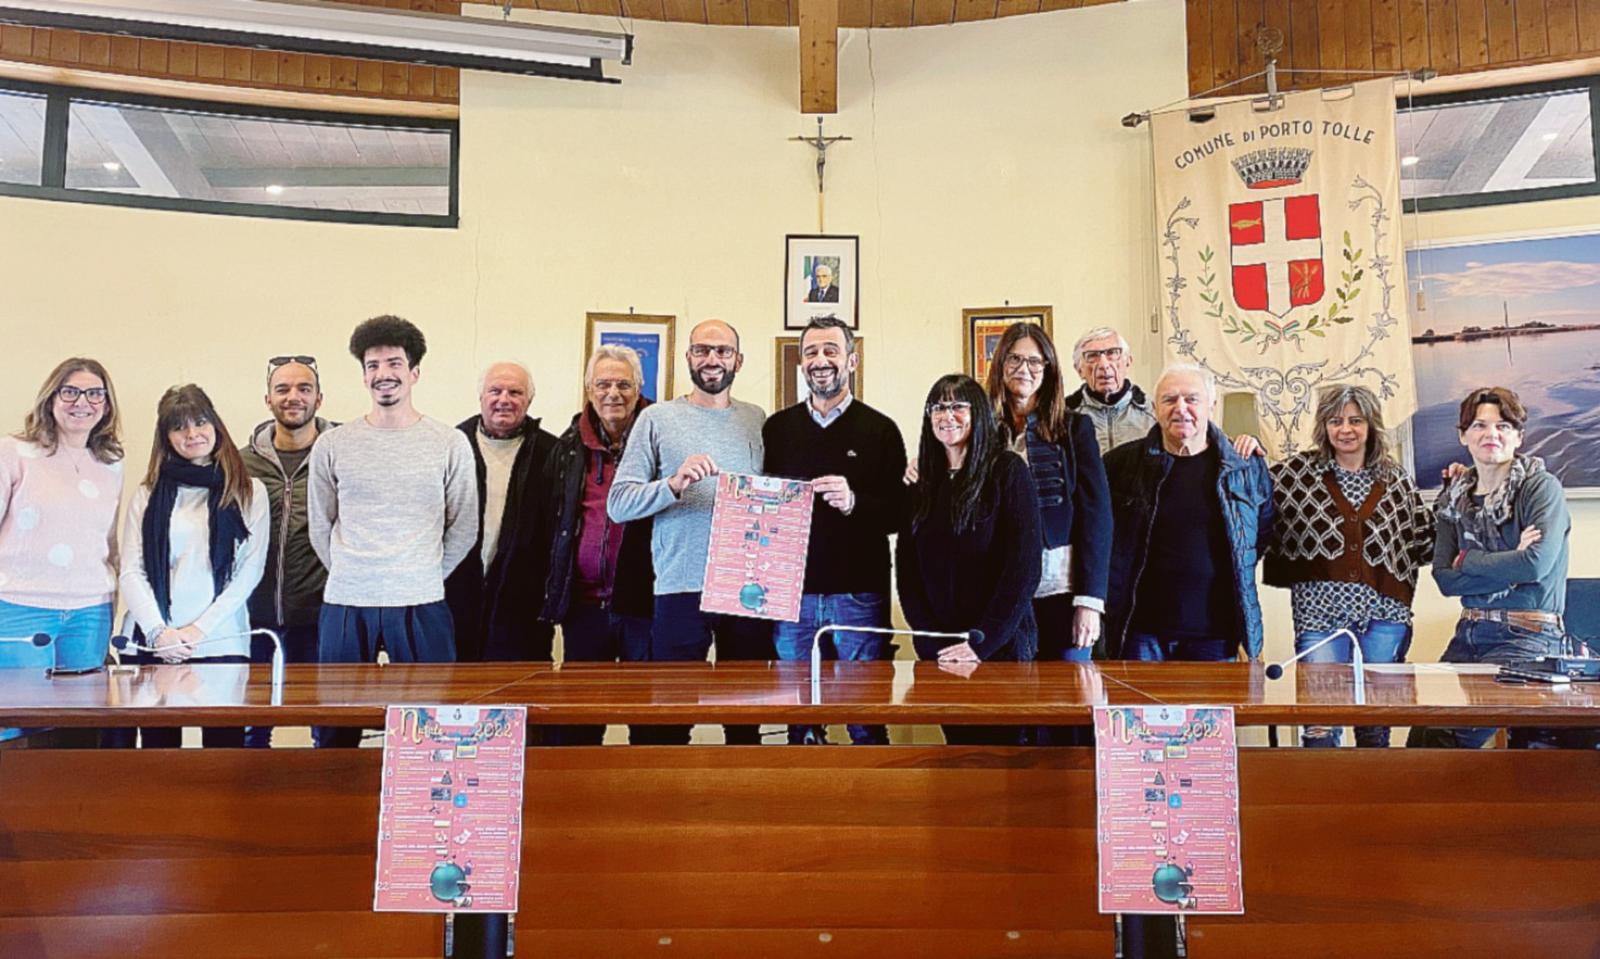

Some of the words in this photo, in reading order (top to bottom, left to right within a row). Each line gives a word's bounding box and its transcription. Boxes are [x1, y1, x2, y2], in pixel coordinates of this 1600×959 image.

[1175, 132, 1235, 169] COMUNE
[1260, 120, 1313, 140] PORTO
[1322, 121, 1375, 145] TOLLE
[475, 721, 513, 739] 2022
[1183, 721, 1223, 740] 2022
